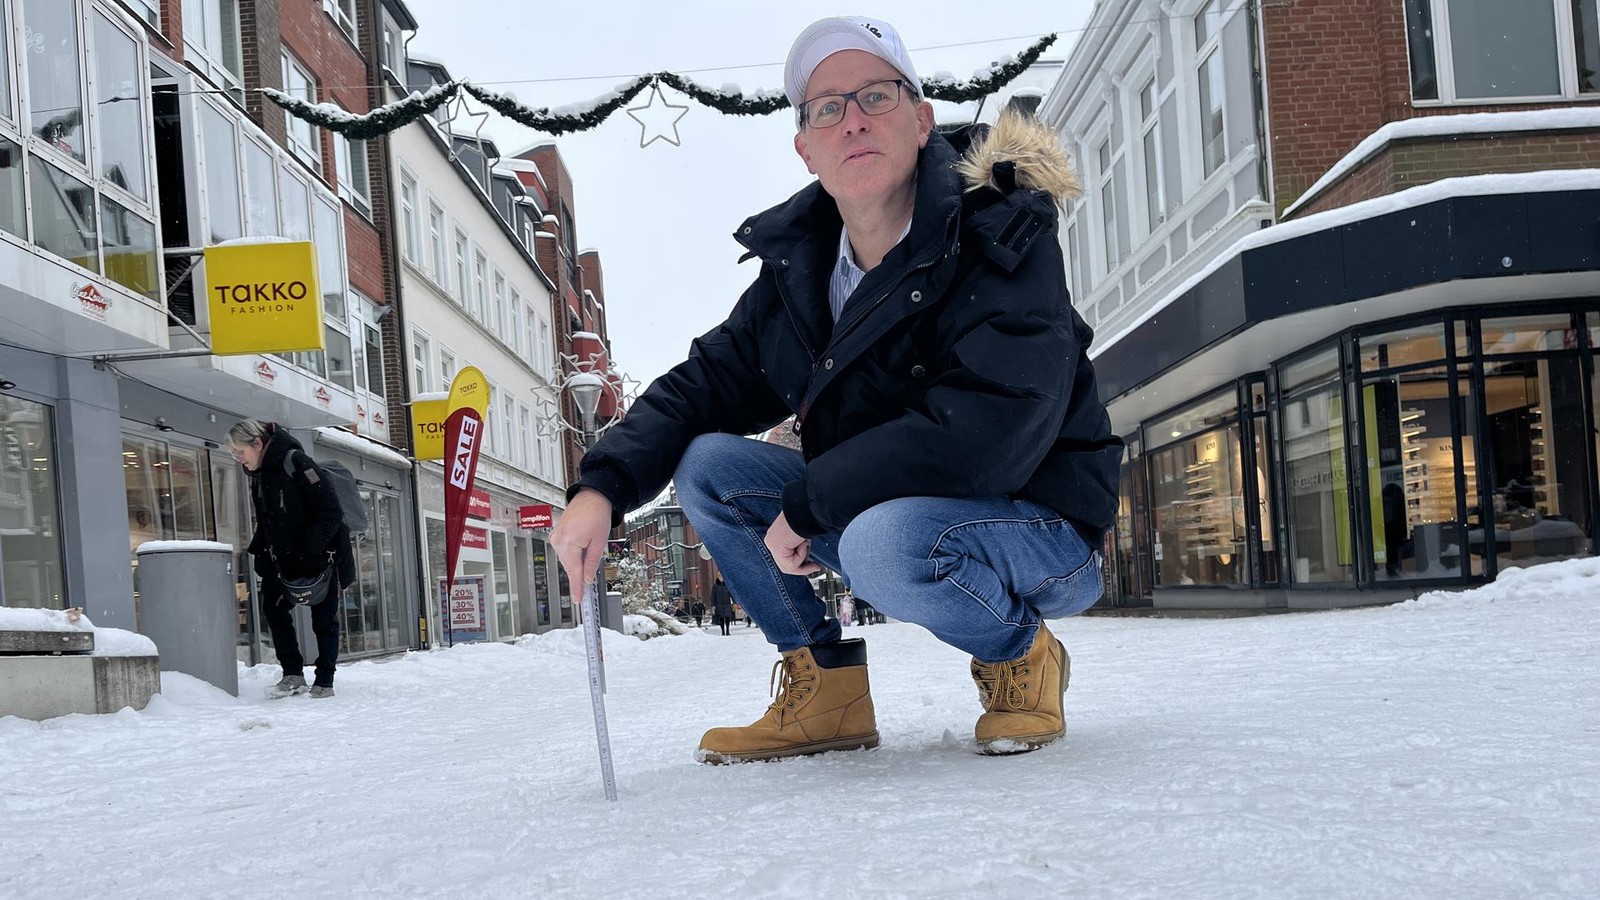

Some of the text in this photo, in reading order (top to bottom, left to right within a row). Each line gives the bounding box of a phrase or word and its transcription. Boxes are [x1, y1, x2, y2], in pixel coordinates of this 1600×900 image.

[230, 303, 294, 314] FASHION
[454, 420, 475, 484] SALE
[521, 514, 550, 523] amplifon
